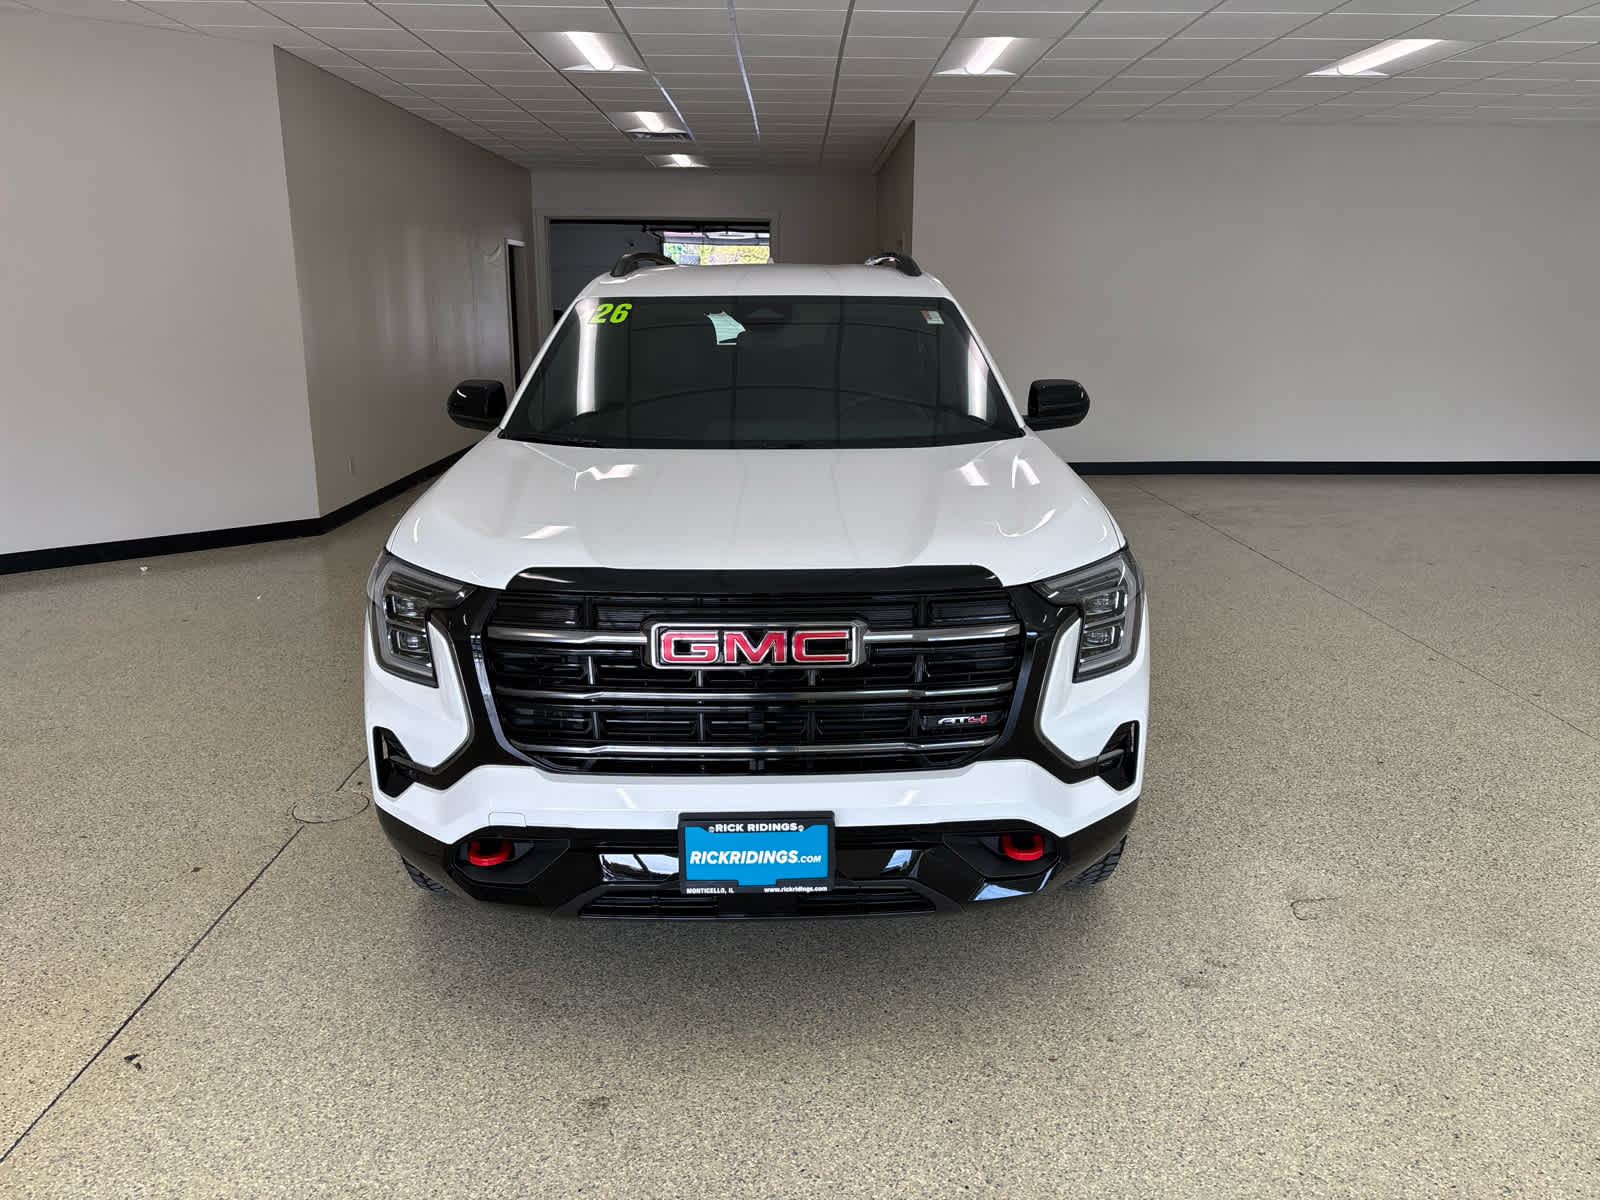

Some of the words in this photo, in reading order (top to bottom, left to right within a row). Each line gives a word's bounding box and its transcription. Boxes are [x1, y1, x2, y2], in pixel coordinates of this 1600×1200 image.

[591, 303, 632, 324] 26
[660, 630, 849, 664] GMC
[937, 714, 988, 725] AT4
[715, 823, 744, 833] RICK
[747, 822, 798, 832] RIDINGS
[689, 849, 822, 865] RICKRIDINGS.COM
[686, 887, 727, 895] MONTICELLO,
[763, 886, 828, 894] www.rickridings.com
